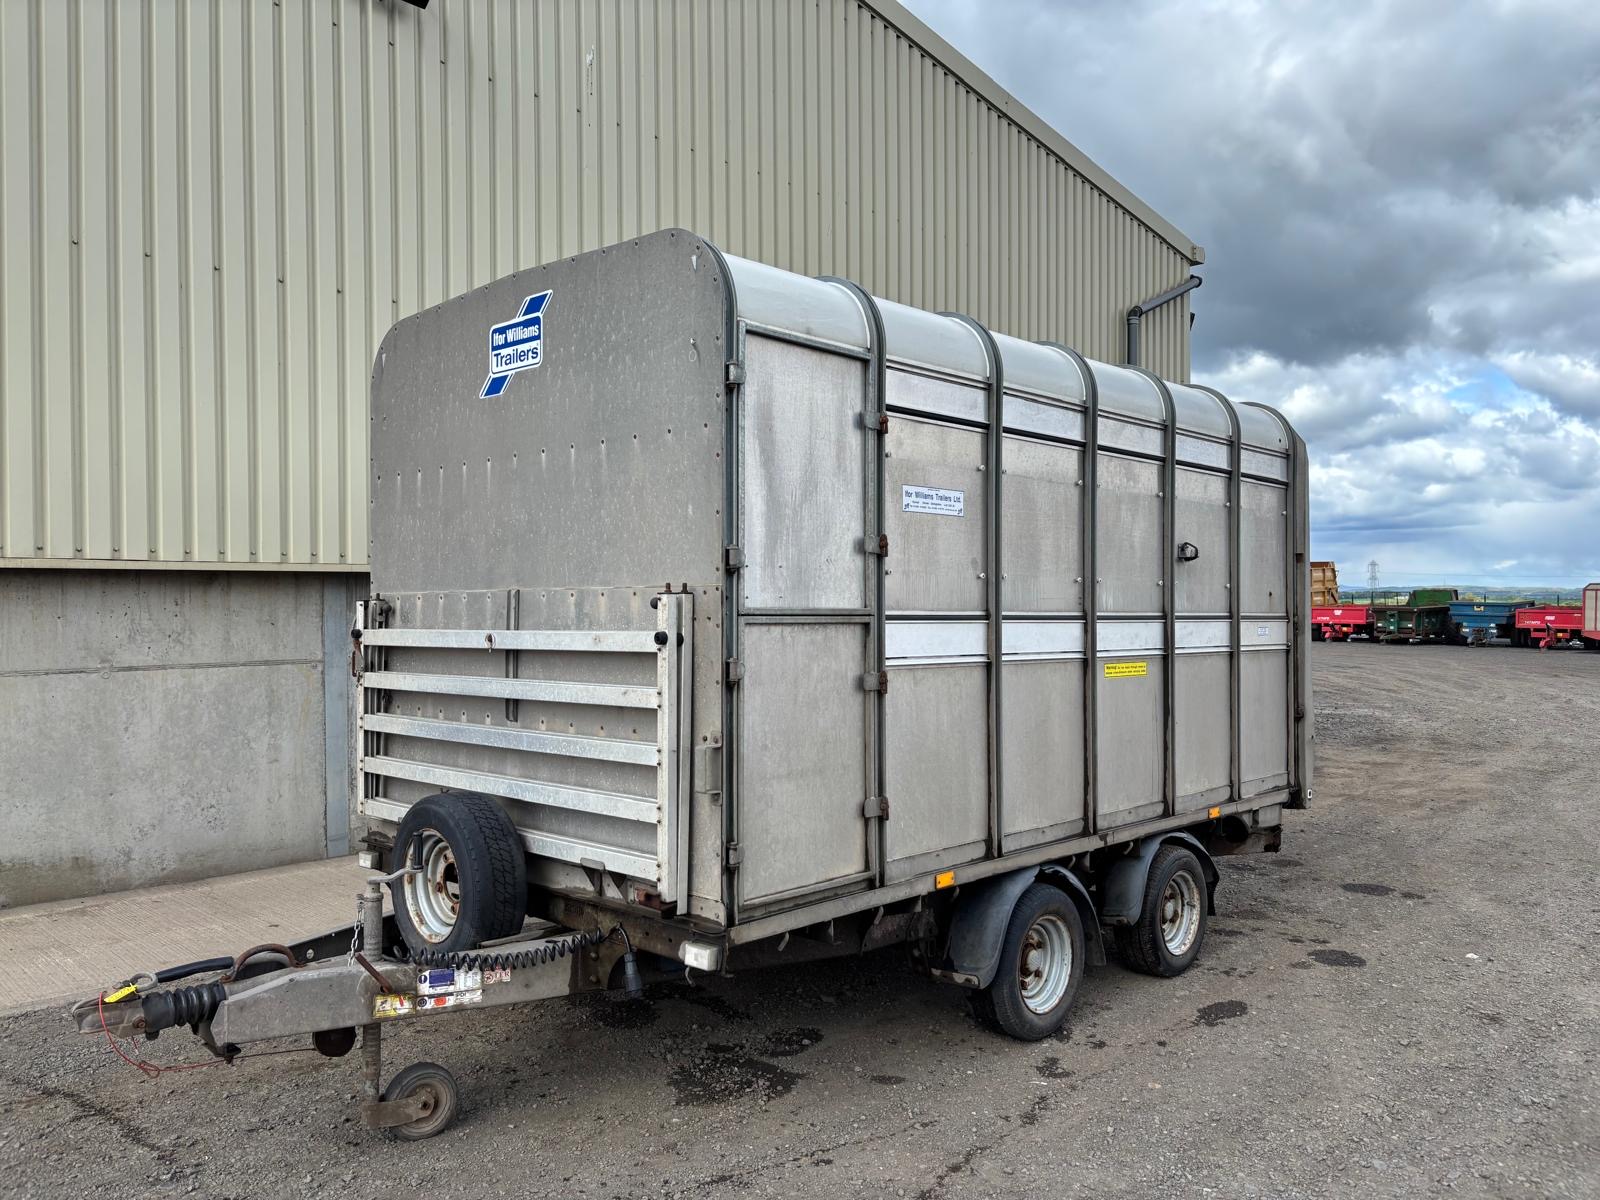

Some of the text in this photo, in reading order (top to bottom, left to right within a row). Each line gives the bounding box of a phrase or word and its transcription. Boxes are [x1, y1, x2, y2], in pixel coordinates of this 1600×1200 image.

[493, 324, 539, 346] Ifor Williams
[493, 346, 539, 367] Trailers
[914, 491, 934, 501] Williams
[935, 493, 952, 503] Trailers
